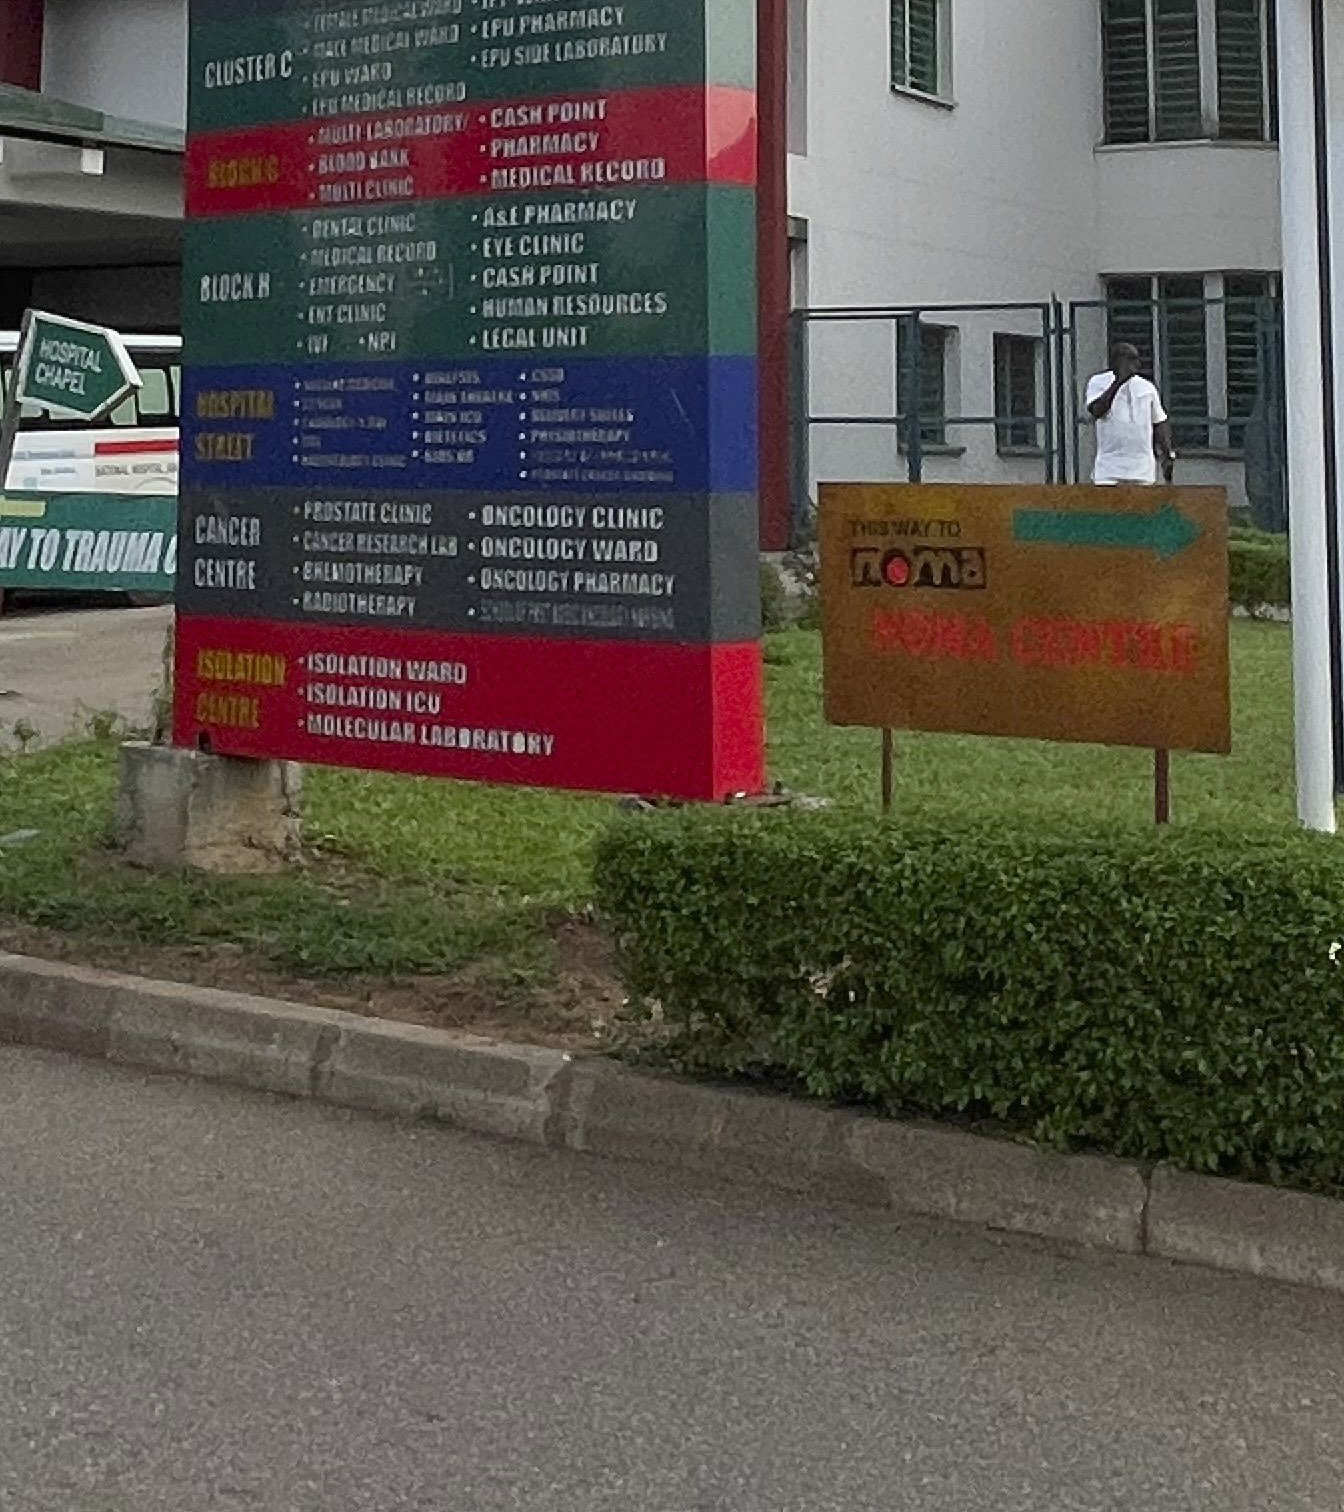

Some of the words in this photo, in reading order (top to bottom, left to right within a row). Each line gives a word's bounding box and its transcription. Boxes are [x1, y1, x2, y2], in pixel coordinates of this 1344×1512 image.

[520, 7, 624, 35] PHARMACY
[556, 33, 667, 61] LABORATORY
[205, 53, 276, 88] CLUSTER
[280, 50, 293, 78] C
[491, 105, 542, 128] CASH
[548, 99, 607, 124] POINT
[491, 131, 599, 158] PHARMACY
[491, 164, 575, 189] MEDICAL
[581, 157, 665, 183] RECORD
[366, 213, 416, 236] CLINIC
[524, 199, 637, 224] PHARMACY
[376, 240, 436, 264] RECORD
[482, 237, 513, 257] EYE
[519, 233, 584, 256] CLINIC
[200, 272, 254, 302] BLOCK
[256, 272, 270, 298] H
[310, 272, 396, 296] EMERGENCY
[483, 266, 534, 288] CASH
[540, 263, 600, 286] POINT
[337, 303, 386, 322] CLINIC
[482, 298, 548, 318] HUMAN
[553, 292, 667, 316] RESOURCES
[482, 328, 536, 349] LEGAL
[542, 326, 588, 348] UNIT
[40, 338, 102, 373] HOSPITAL
[35, 364, 85, 396] CHAPEL
[303, 501, 377, 524] PROSTATE
[380, 503, 432, 524] CLINIC
[481, 505, 585, 529] ONCOLOGY
[592, 506, 664, 530] CLINIC
[194, 515, 260, 548] CANCER
[891, 520, 930, 538] WAY
[937, 520, 961, 538] TO
[27, 528, 59, 571] TO
[62, 530, 164, 573] TRAUMA
[303, 530, 354, 552] CANCER
[356, 533, 427, 554] RESEARCH
[430, 536, 458, 557] LAB
[481, 536, 586, 561] ONCOLOGY
[593, 539, 658, 562] WARD
[194, 558, 256, 590] CENTRE
[481, 569, 569, 593] ONCOLOGY
[573, 571, 675, 596] PHARMACY
[302, 592, 415, 617] RADIOTHERAPY
[871, 606, 997, 663] NOMA
[198, 648, 285, 686] ISOLATION
[307, 652, 401, 681] ISOLATION
[408, 659, 466, 684] WARD
[306, 683, 401, 710] ISOLATION
[407, 689, 440, 714] ICU
[307, 714, 415, 744] MOLECULAR
[420, 726, 554, 756] LABORATORY
